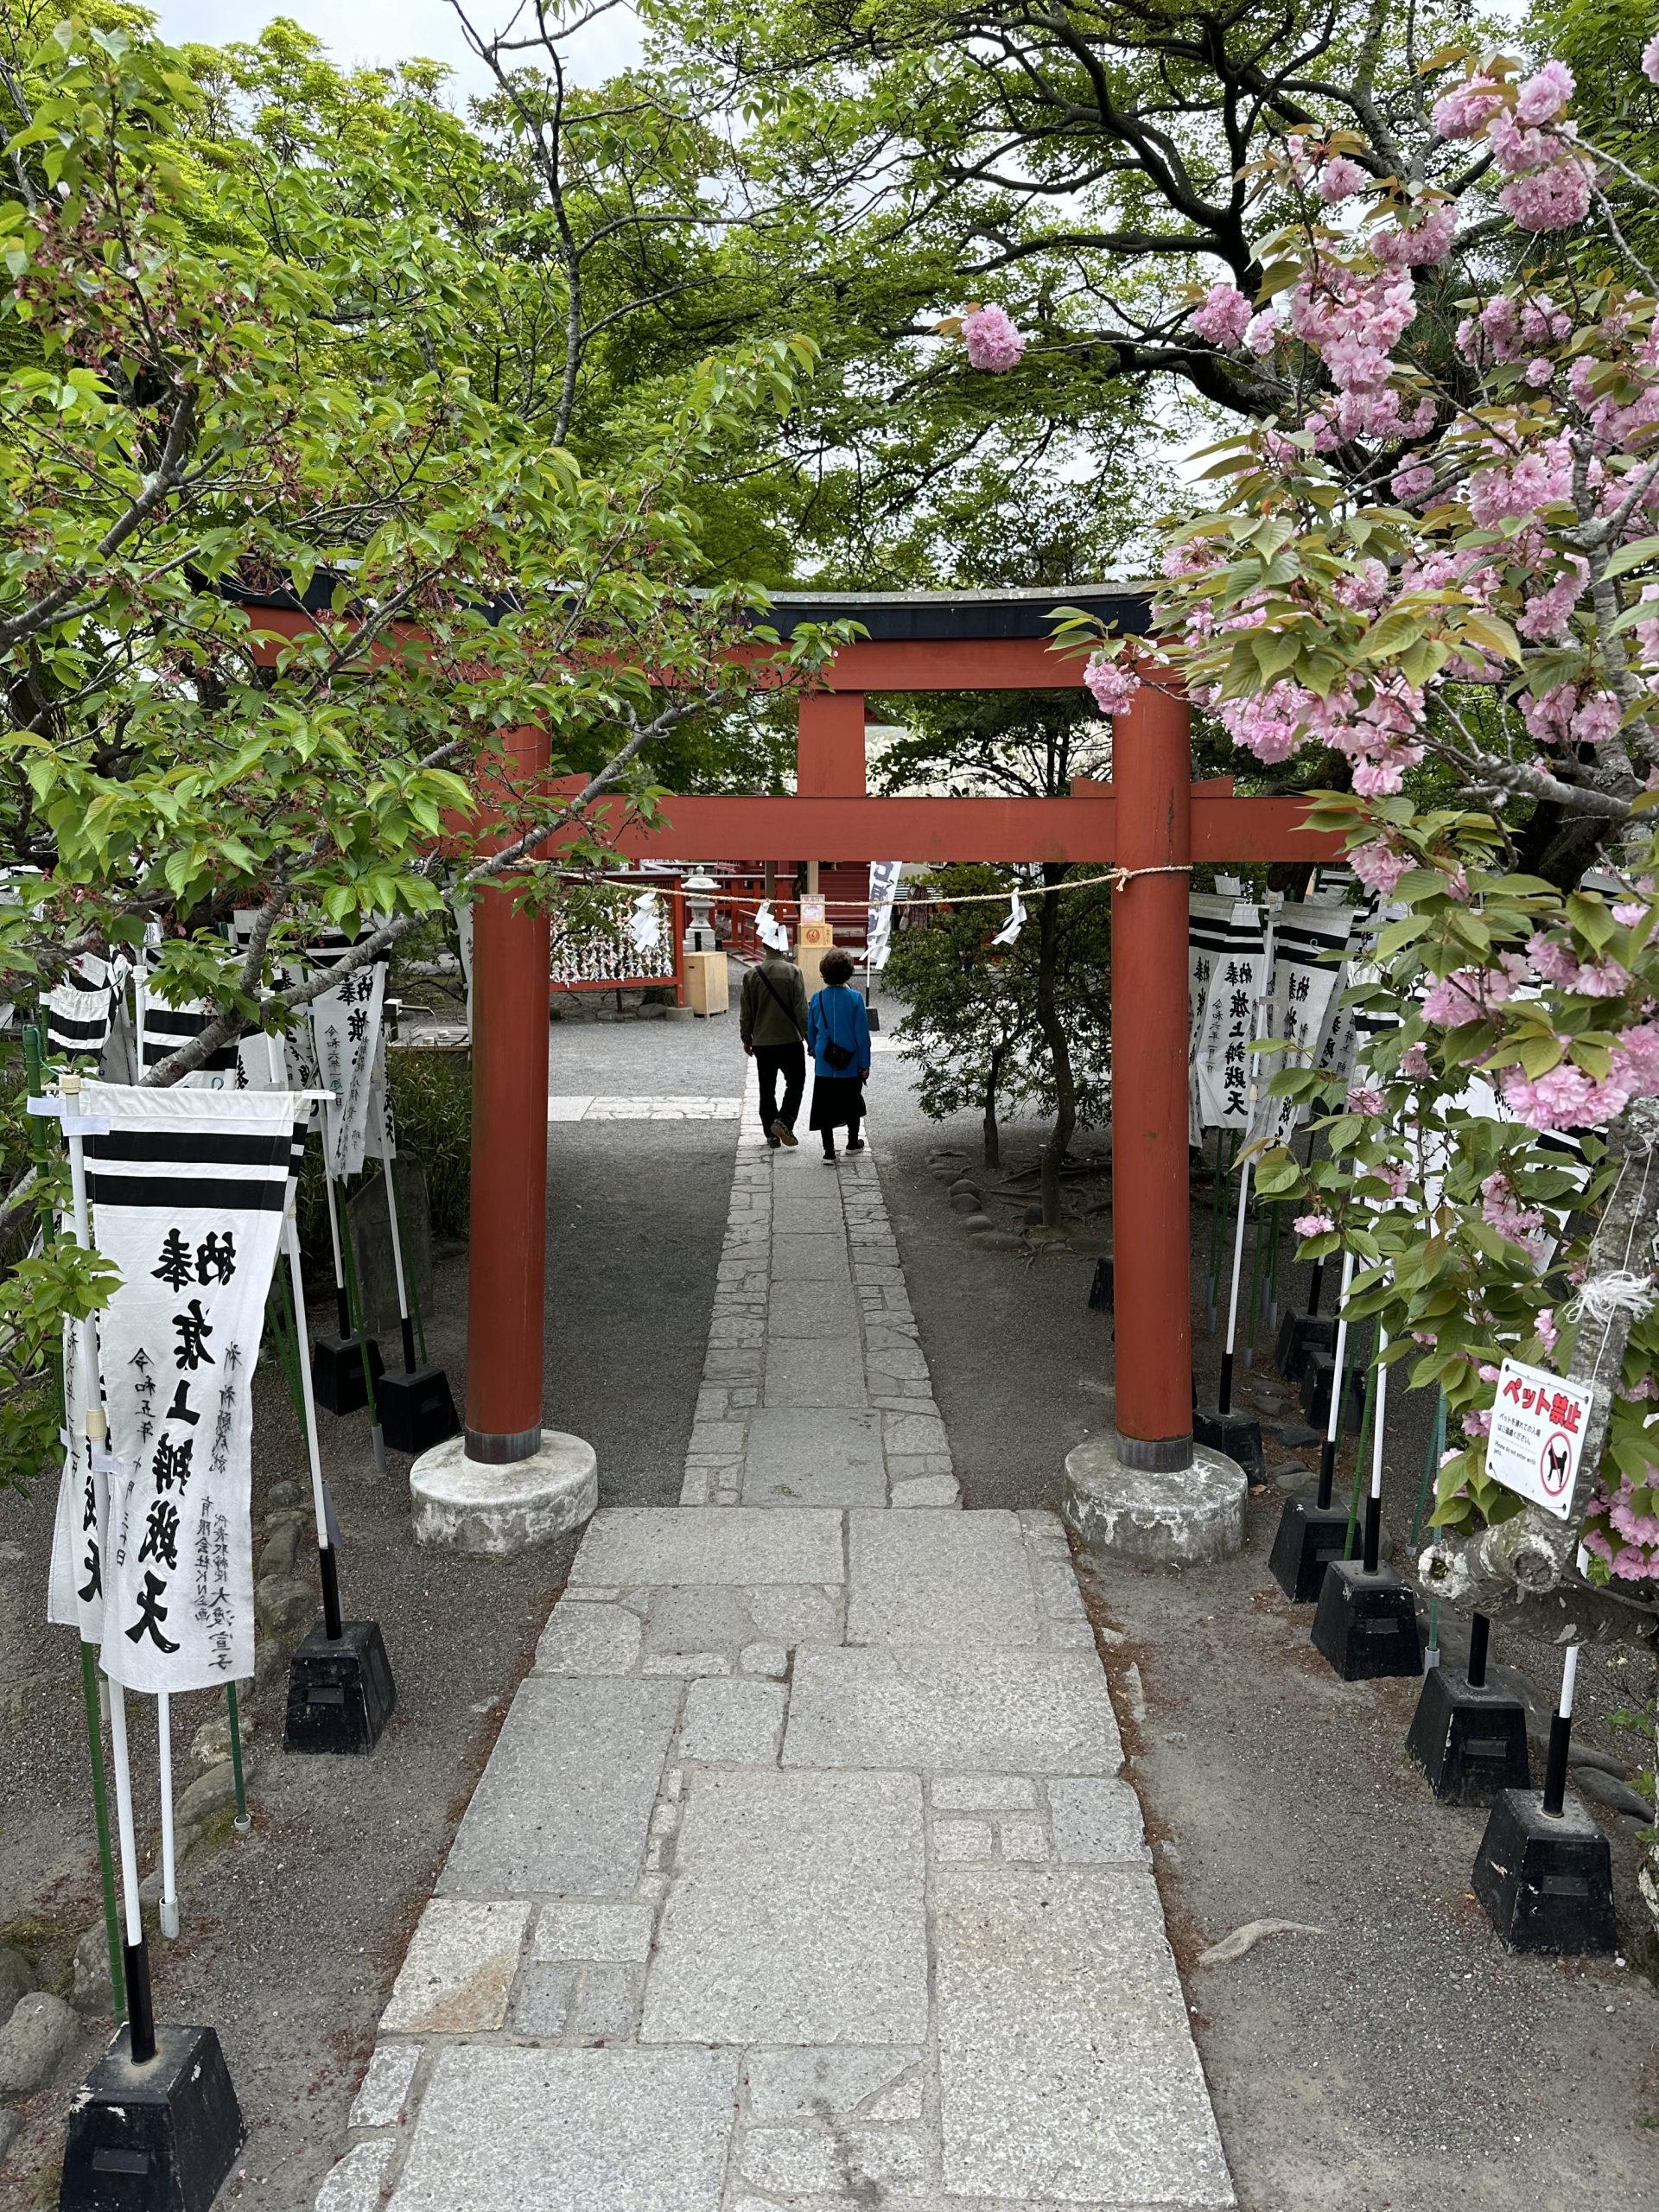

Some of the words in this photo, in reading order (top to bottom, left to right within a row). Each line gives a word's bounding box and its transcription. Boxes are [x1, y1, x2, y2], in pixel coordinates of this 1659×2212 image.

[1503, 1378, 1582, 1434] ペット禁止
